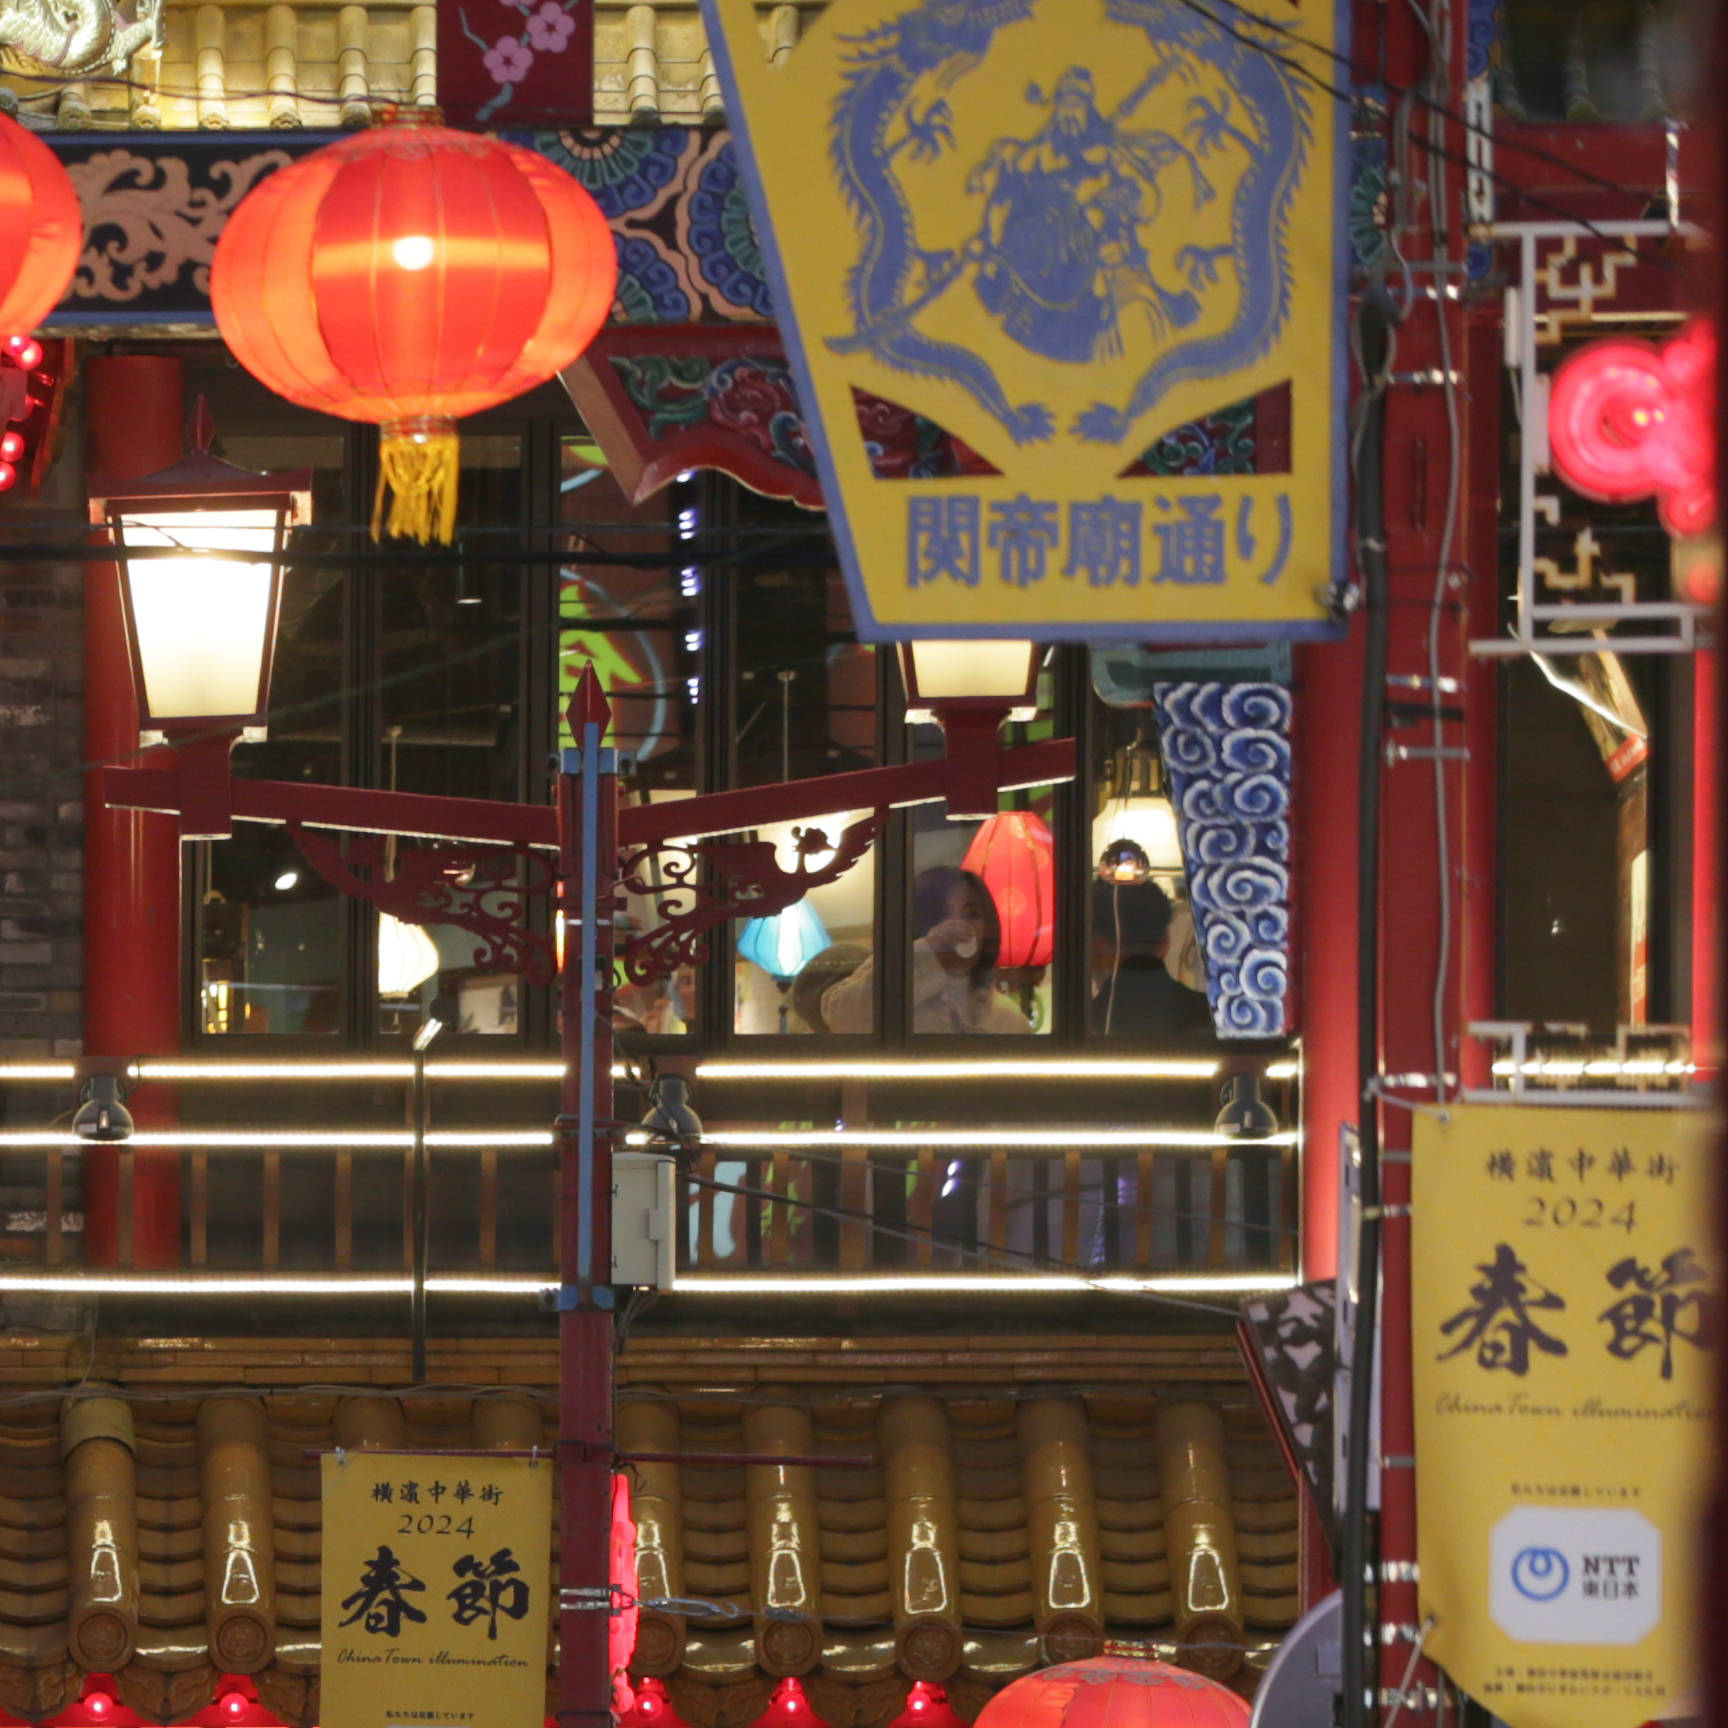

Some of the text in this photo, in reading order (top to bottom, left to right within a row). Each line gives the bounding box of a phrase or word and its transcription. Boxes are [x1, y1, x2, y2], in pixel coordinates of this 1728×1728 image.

[906, 493, 1293, 588] 関帝廟通り
[1521, 1196, 1639, 1235] 2024
[1435, 1243, 1711, 1381] 春節
[371, 1480, 504, 1506] 横濱中華街
[396, 1513, 475, 1540] 2024
[1582, 1554, 1641, 1577] NTT
[338, 1545, 530, 1641] 春節
[1582, 1581, 1640, 1600] 東日本
